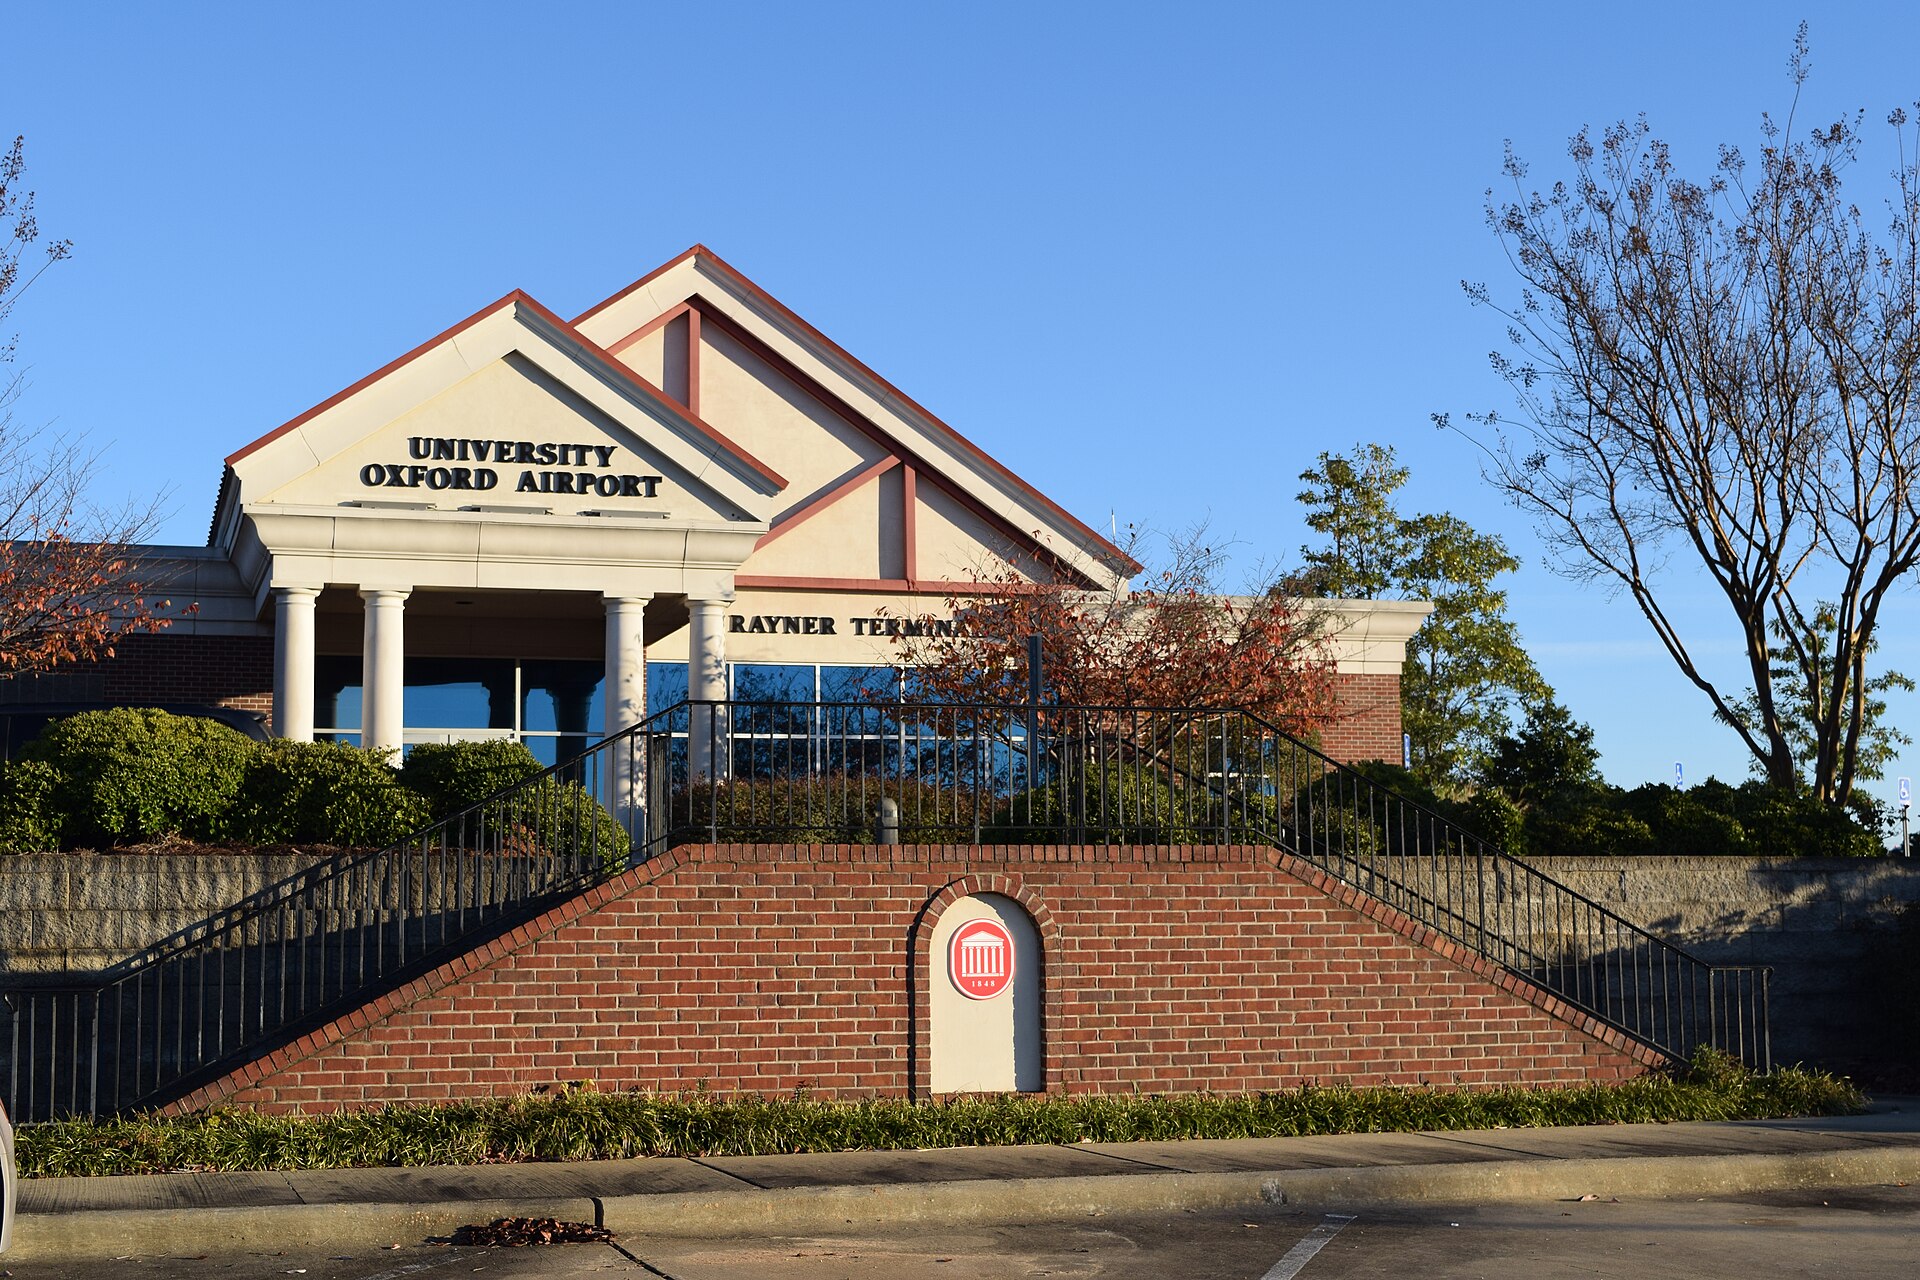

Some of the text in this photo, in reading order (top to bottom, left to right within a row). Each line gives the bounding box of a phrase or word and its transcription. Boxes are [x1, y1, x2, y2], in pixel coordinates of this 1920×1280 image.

[407, 436, 618, 467] UNIVERSITY
[360, 463, 662, 498] OXFORD AIRPORT
[729, 614, 986, 638] RAYNER TERMIN
